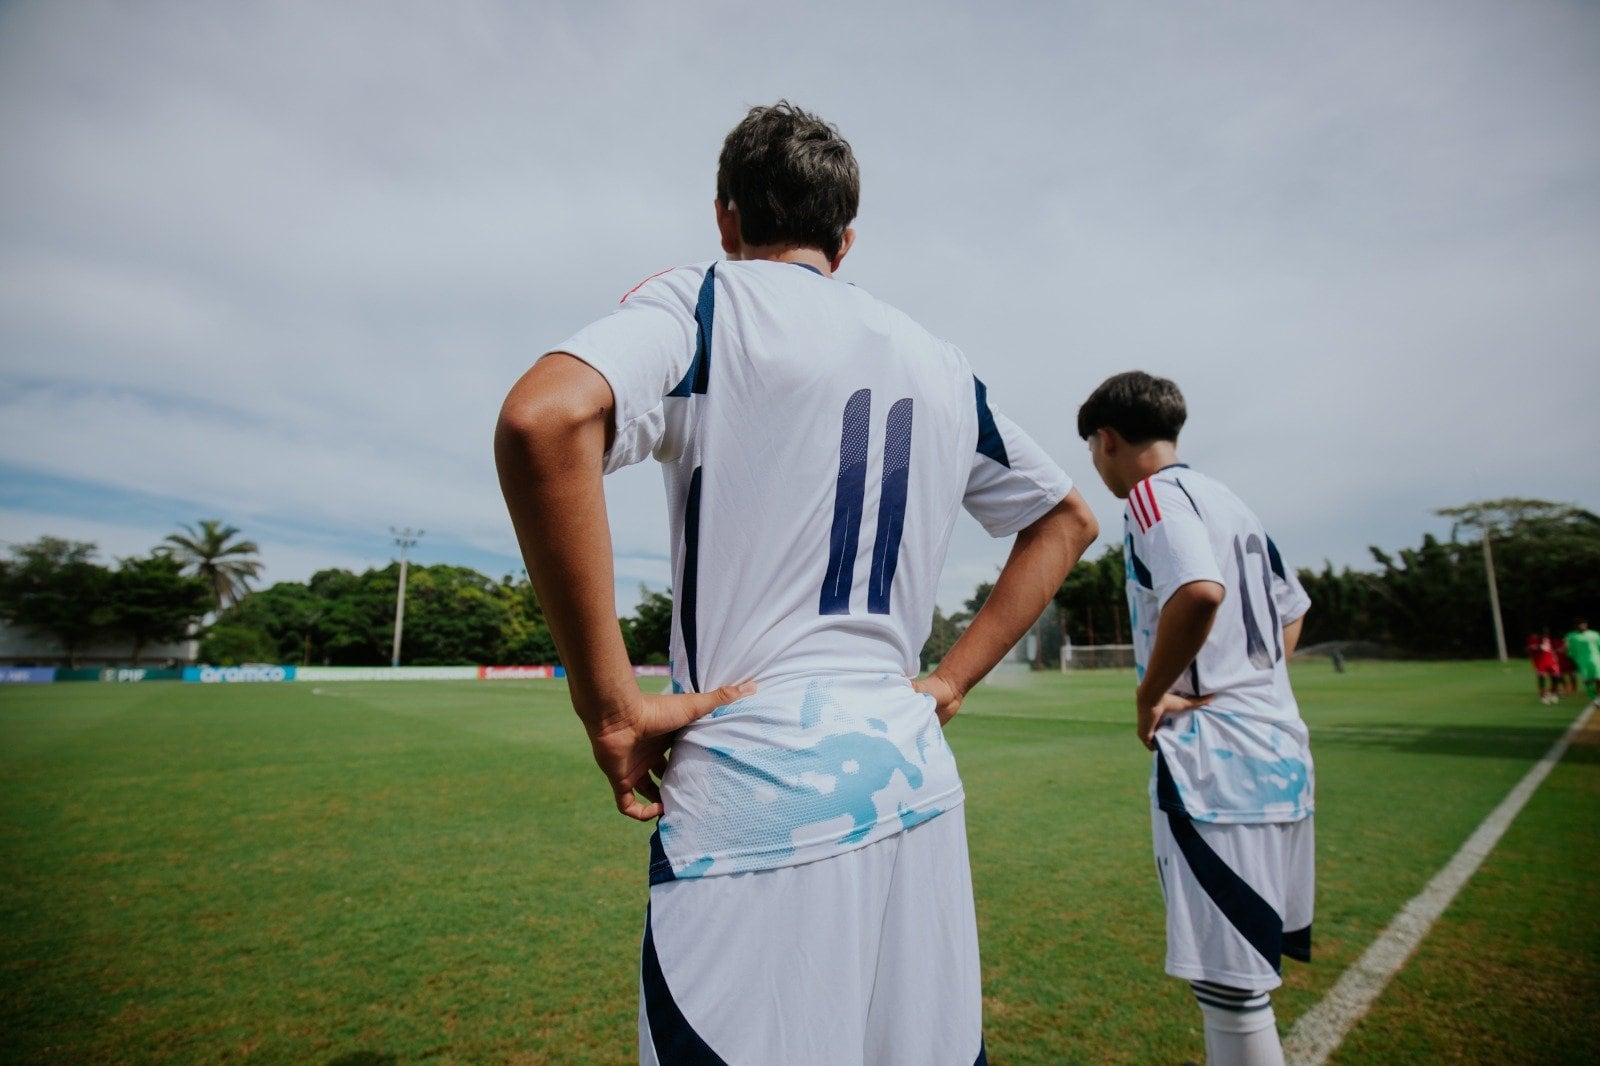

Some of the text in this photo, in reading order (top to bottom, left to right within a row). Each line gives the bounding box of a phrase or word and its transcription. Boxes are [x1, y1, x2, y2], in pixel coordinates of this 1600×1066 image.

[819, 388, 914, 615] 11
[117, 668, 147, 683] PIF
[200, 666, 287, 683] aramco
